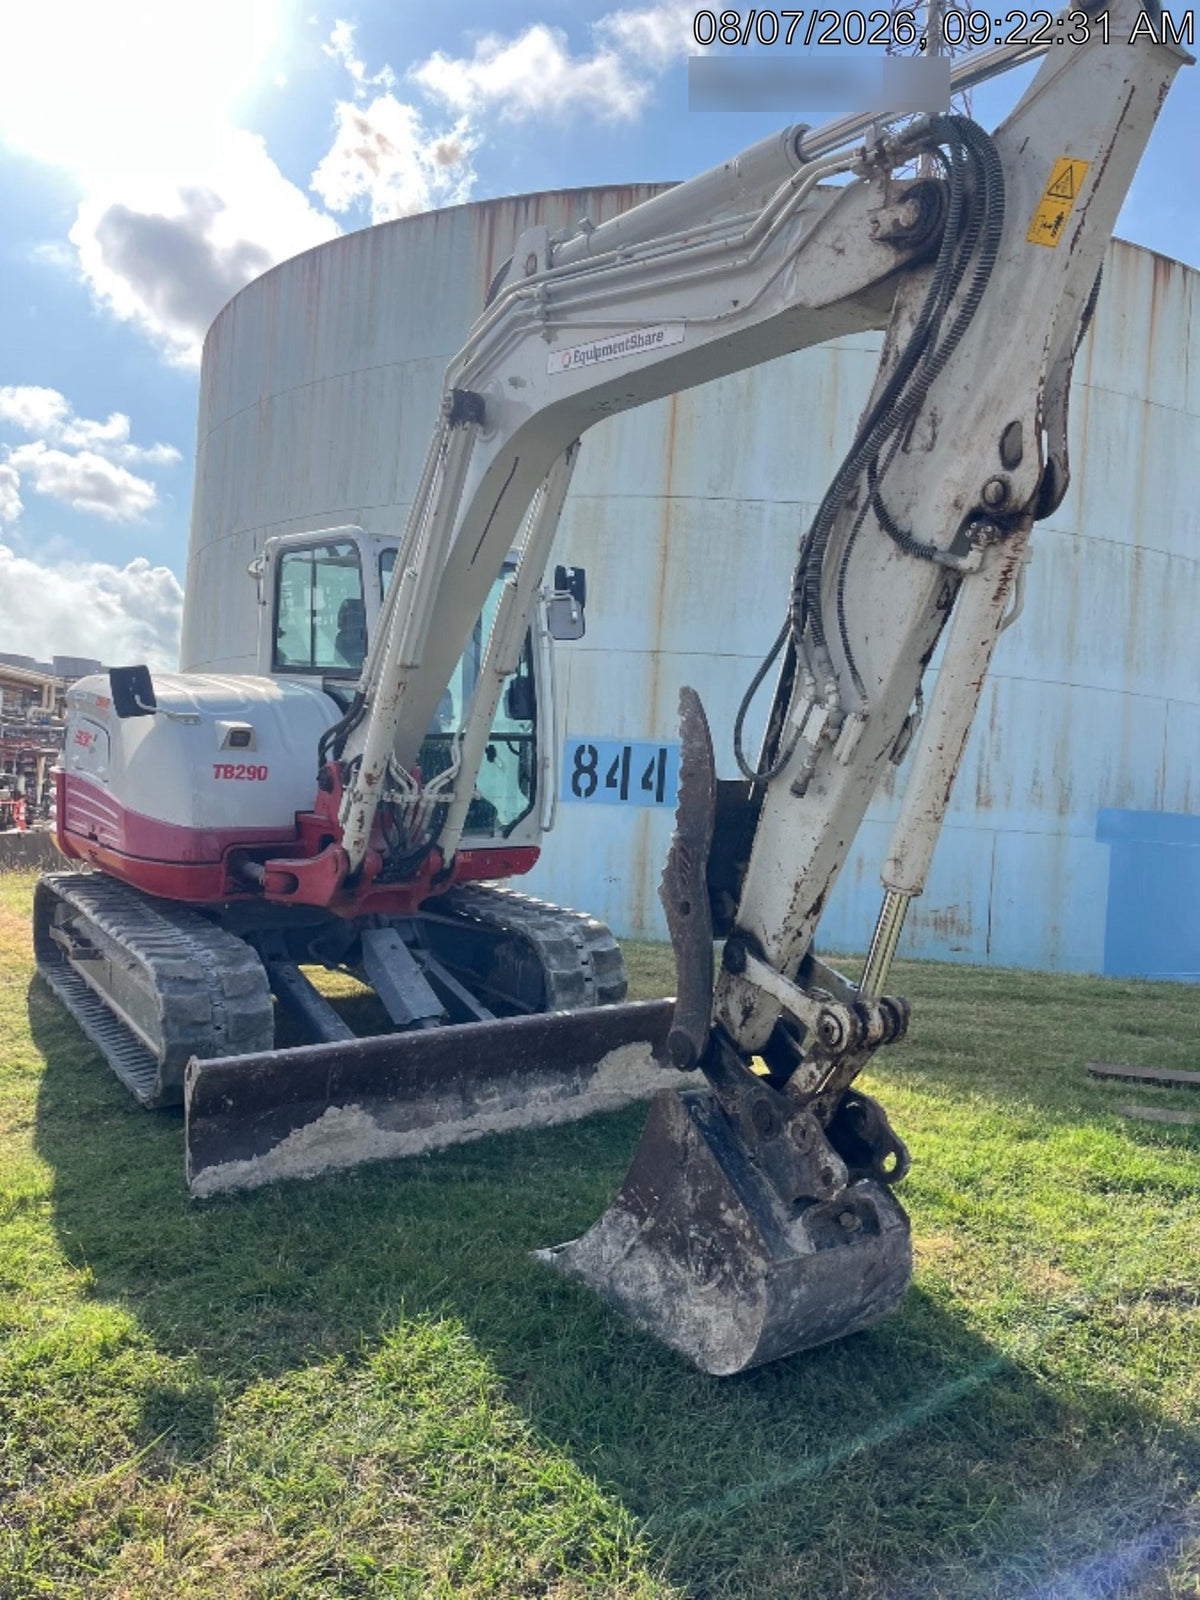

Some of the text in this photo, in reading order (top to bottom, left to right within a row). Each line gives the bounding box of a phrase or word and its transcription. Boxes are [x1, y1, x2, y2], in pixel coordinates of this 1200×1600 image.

[573, 331, 664, 364] EquipmentShare
[213, 764, 268, 781] TB290
[571, 744, 667, 802] 844
